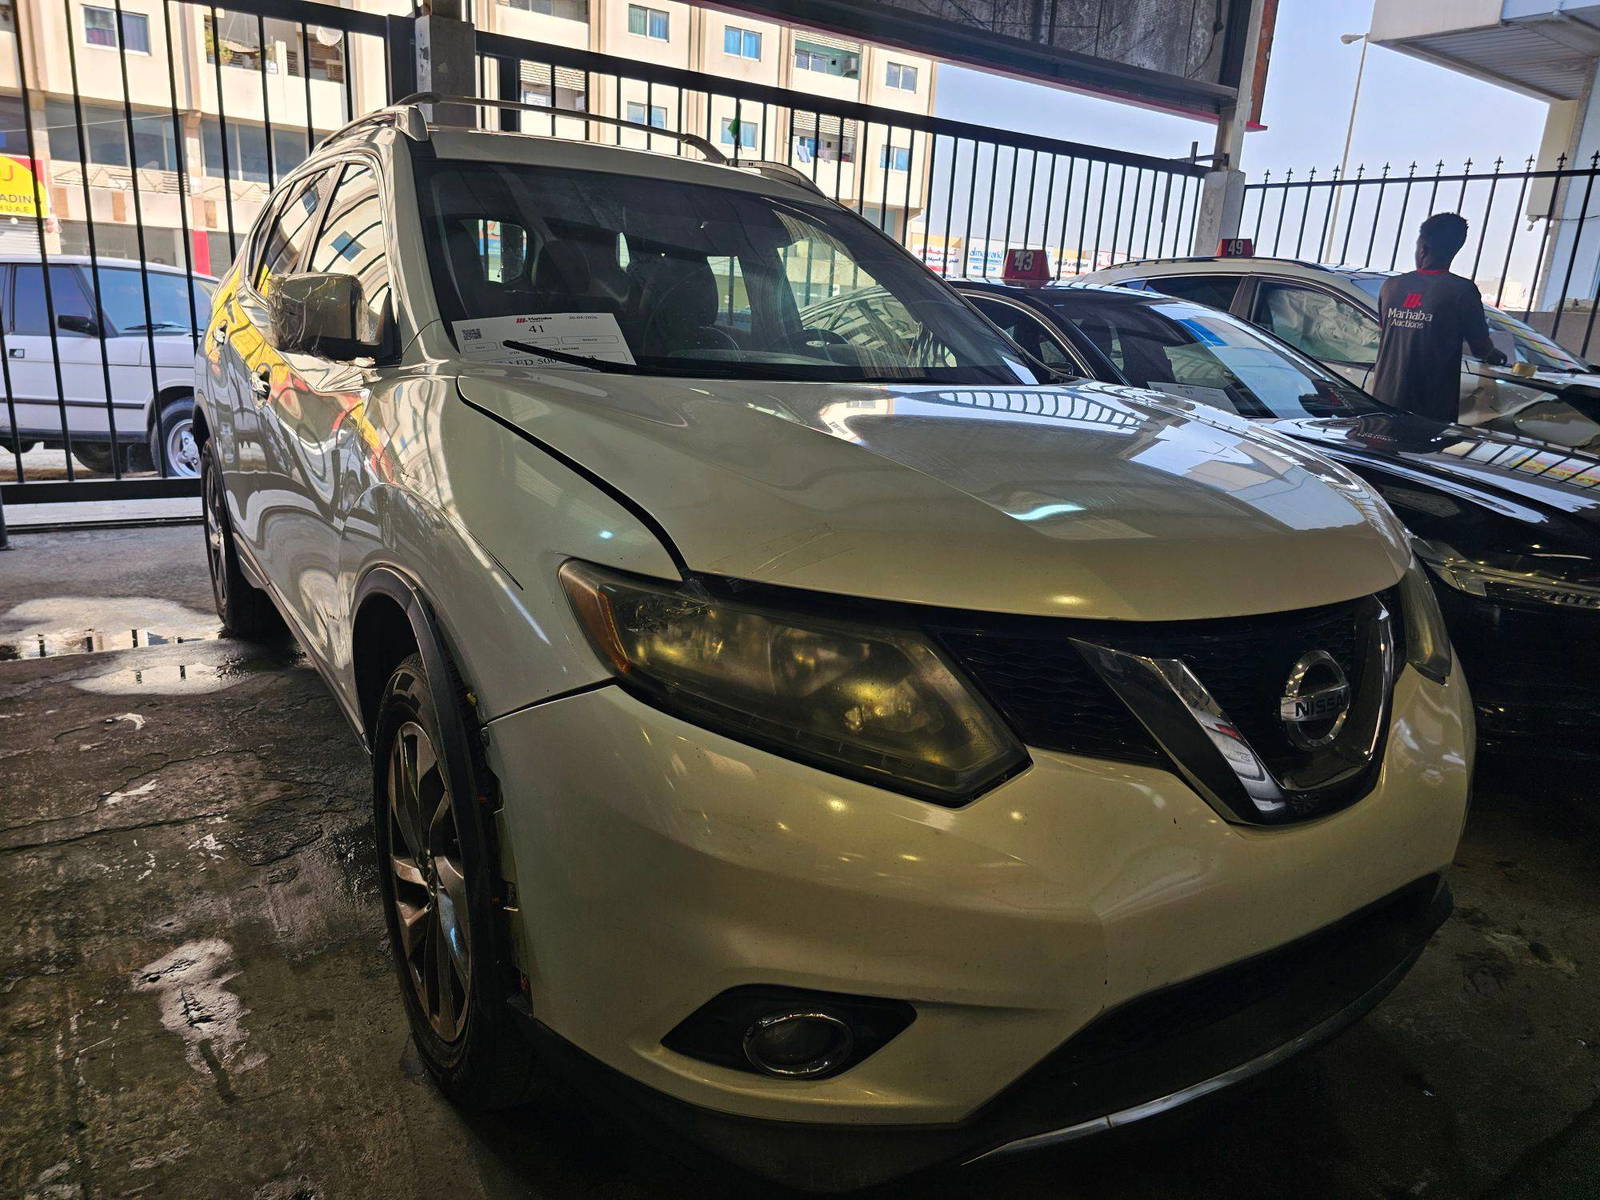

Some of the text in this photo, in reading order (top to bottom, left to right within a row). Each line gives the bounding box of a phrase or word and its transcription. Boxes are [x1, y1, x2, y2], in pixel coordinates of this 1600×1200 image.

[1228, 239, 1244, 256] 49
[1014, 250, 1034, 272] 43
[1387, 307, 1433, 322] Marhaba
[528, 325, 545, 333] 41
[1390, 319, 1424, 328] Auctions
[1295, 687, 1346, 718] NISSA
